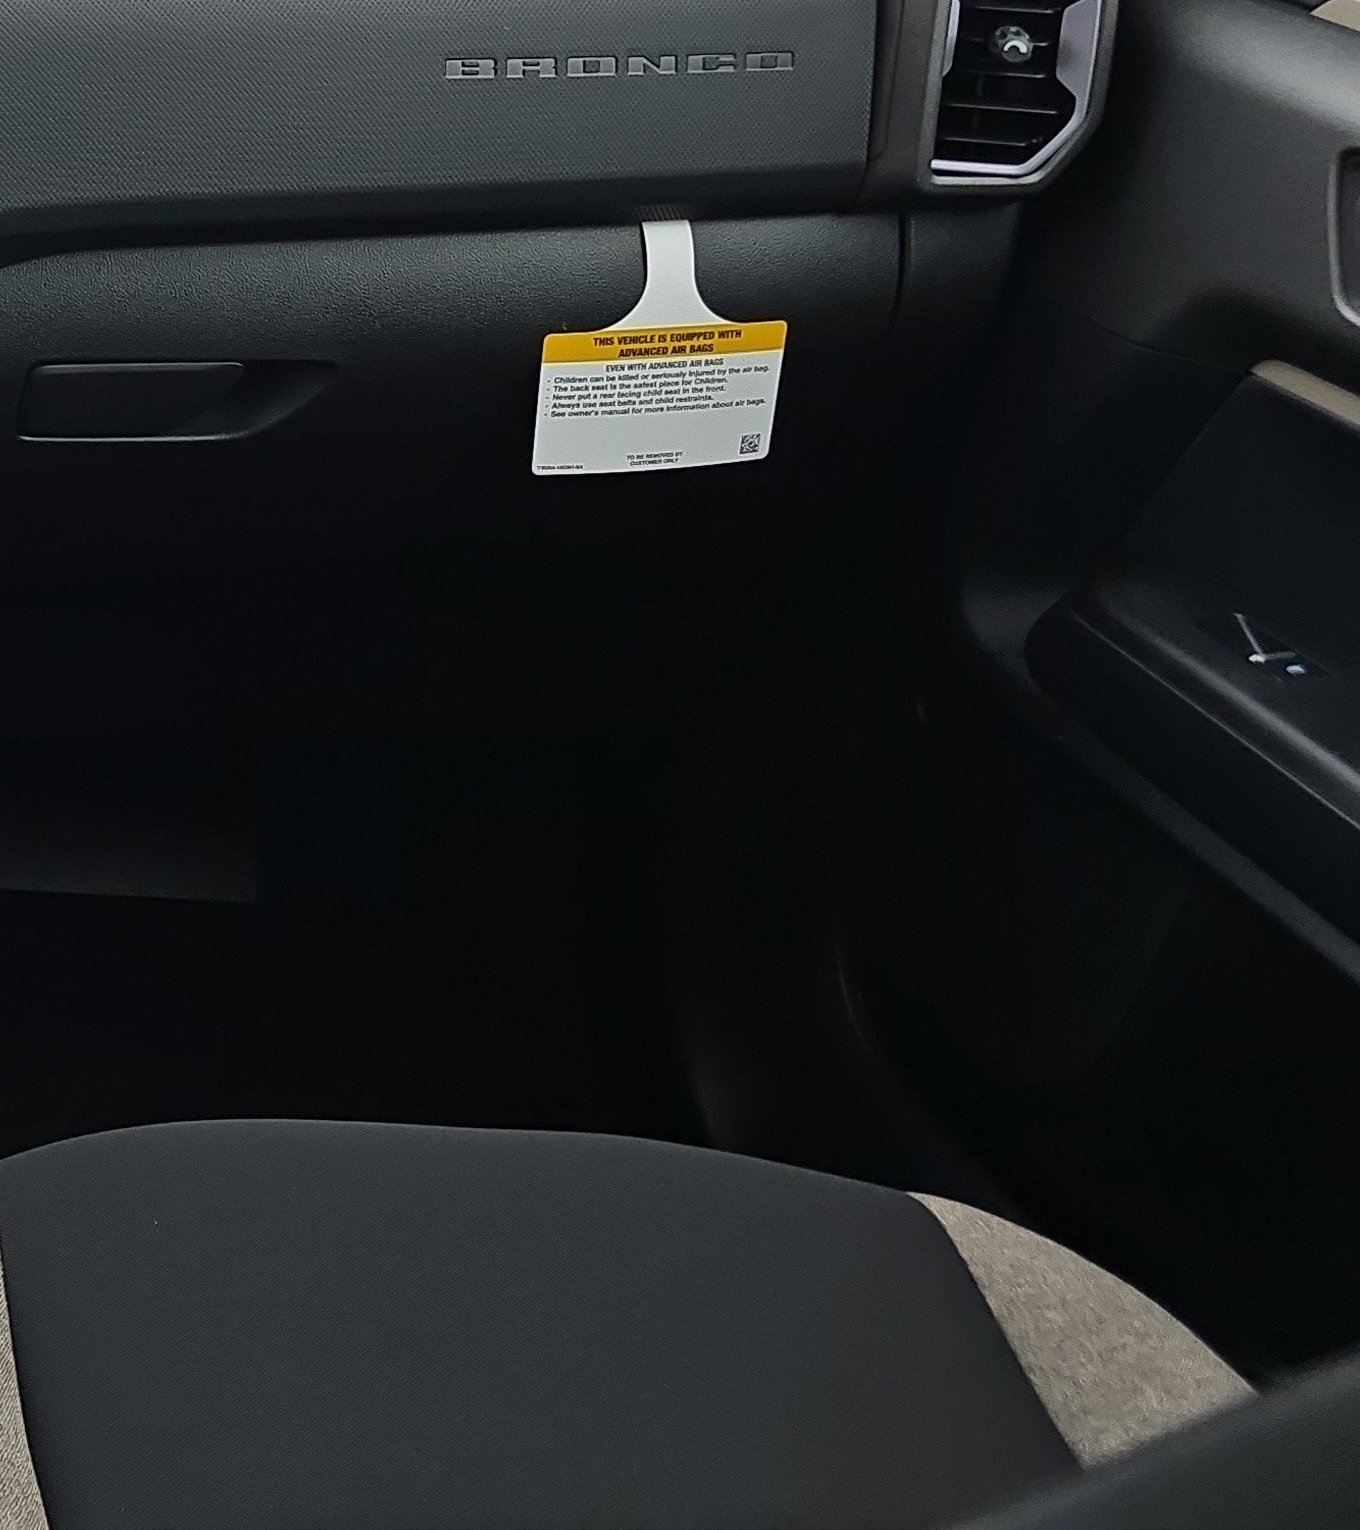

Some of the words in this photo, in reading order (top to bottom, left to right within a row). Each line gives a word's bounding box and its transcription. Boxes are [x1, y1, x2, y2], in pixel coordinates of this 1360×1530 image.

[444, 51, 794, 80] BRONCO
[593, 337, 614, 347] THIS
[617, 334, 655, 346] VEHICLE
[658, 334, 667, 343] IS
[670, 331, 715, 342] EQUIPPED
[718, 329, 742, 340] WITH
[618, 346, 668, 358] ADVANCED
[672, 344, 687, 354] AIR
[690, 344, 714, 354] BAGS
[606, 364, 626, 372] EVEN
[627, 363, 646, 372] WITH
[648, 360, 688, 370] ADVANCED
[690, 359, 702, 367] AIR
[704, 358, 724, 366] BAGS
[554, 376, 588, 384] Children
[590, 376, 604, 384] can
[606, 374, 616, 382] be
[618, 373, 639, 381] killed
[651, 370, 687, 380] seriously
[688, 368, 715, 378] injured
[716, 368, 727, 376] by
[728, 366, 740, 374] the
[570, 384, 590, 392] back
[618, 382, 632, 390] the
[633, 381, 658, 389] safest
[659, 380, 680, 388] place
[681, 378, 693, 386] for
[552, 393, 576, 401] Never
[578, 393, 591, 401] put
[617, 390, 641, 399] facing
[642, 388, 662, 396] child
[691, 386, 704, 394] the
[551, 402, 580, 410] Always
[617, 399, 636, 407] belts
[638, 398, 653, 406] and
[654, 396, 674, 404] child
[551, 410, 566, 418] See
[601, 408, 630, 416] manual
[644, 406, 664, 414] more
[666, 404, 710, 412] information
